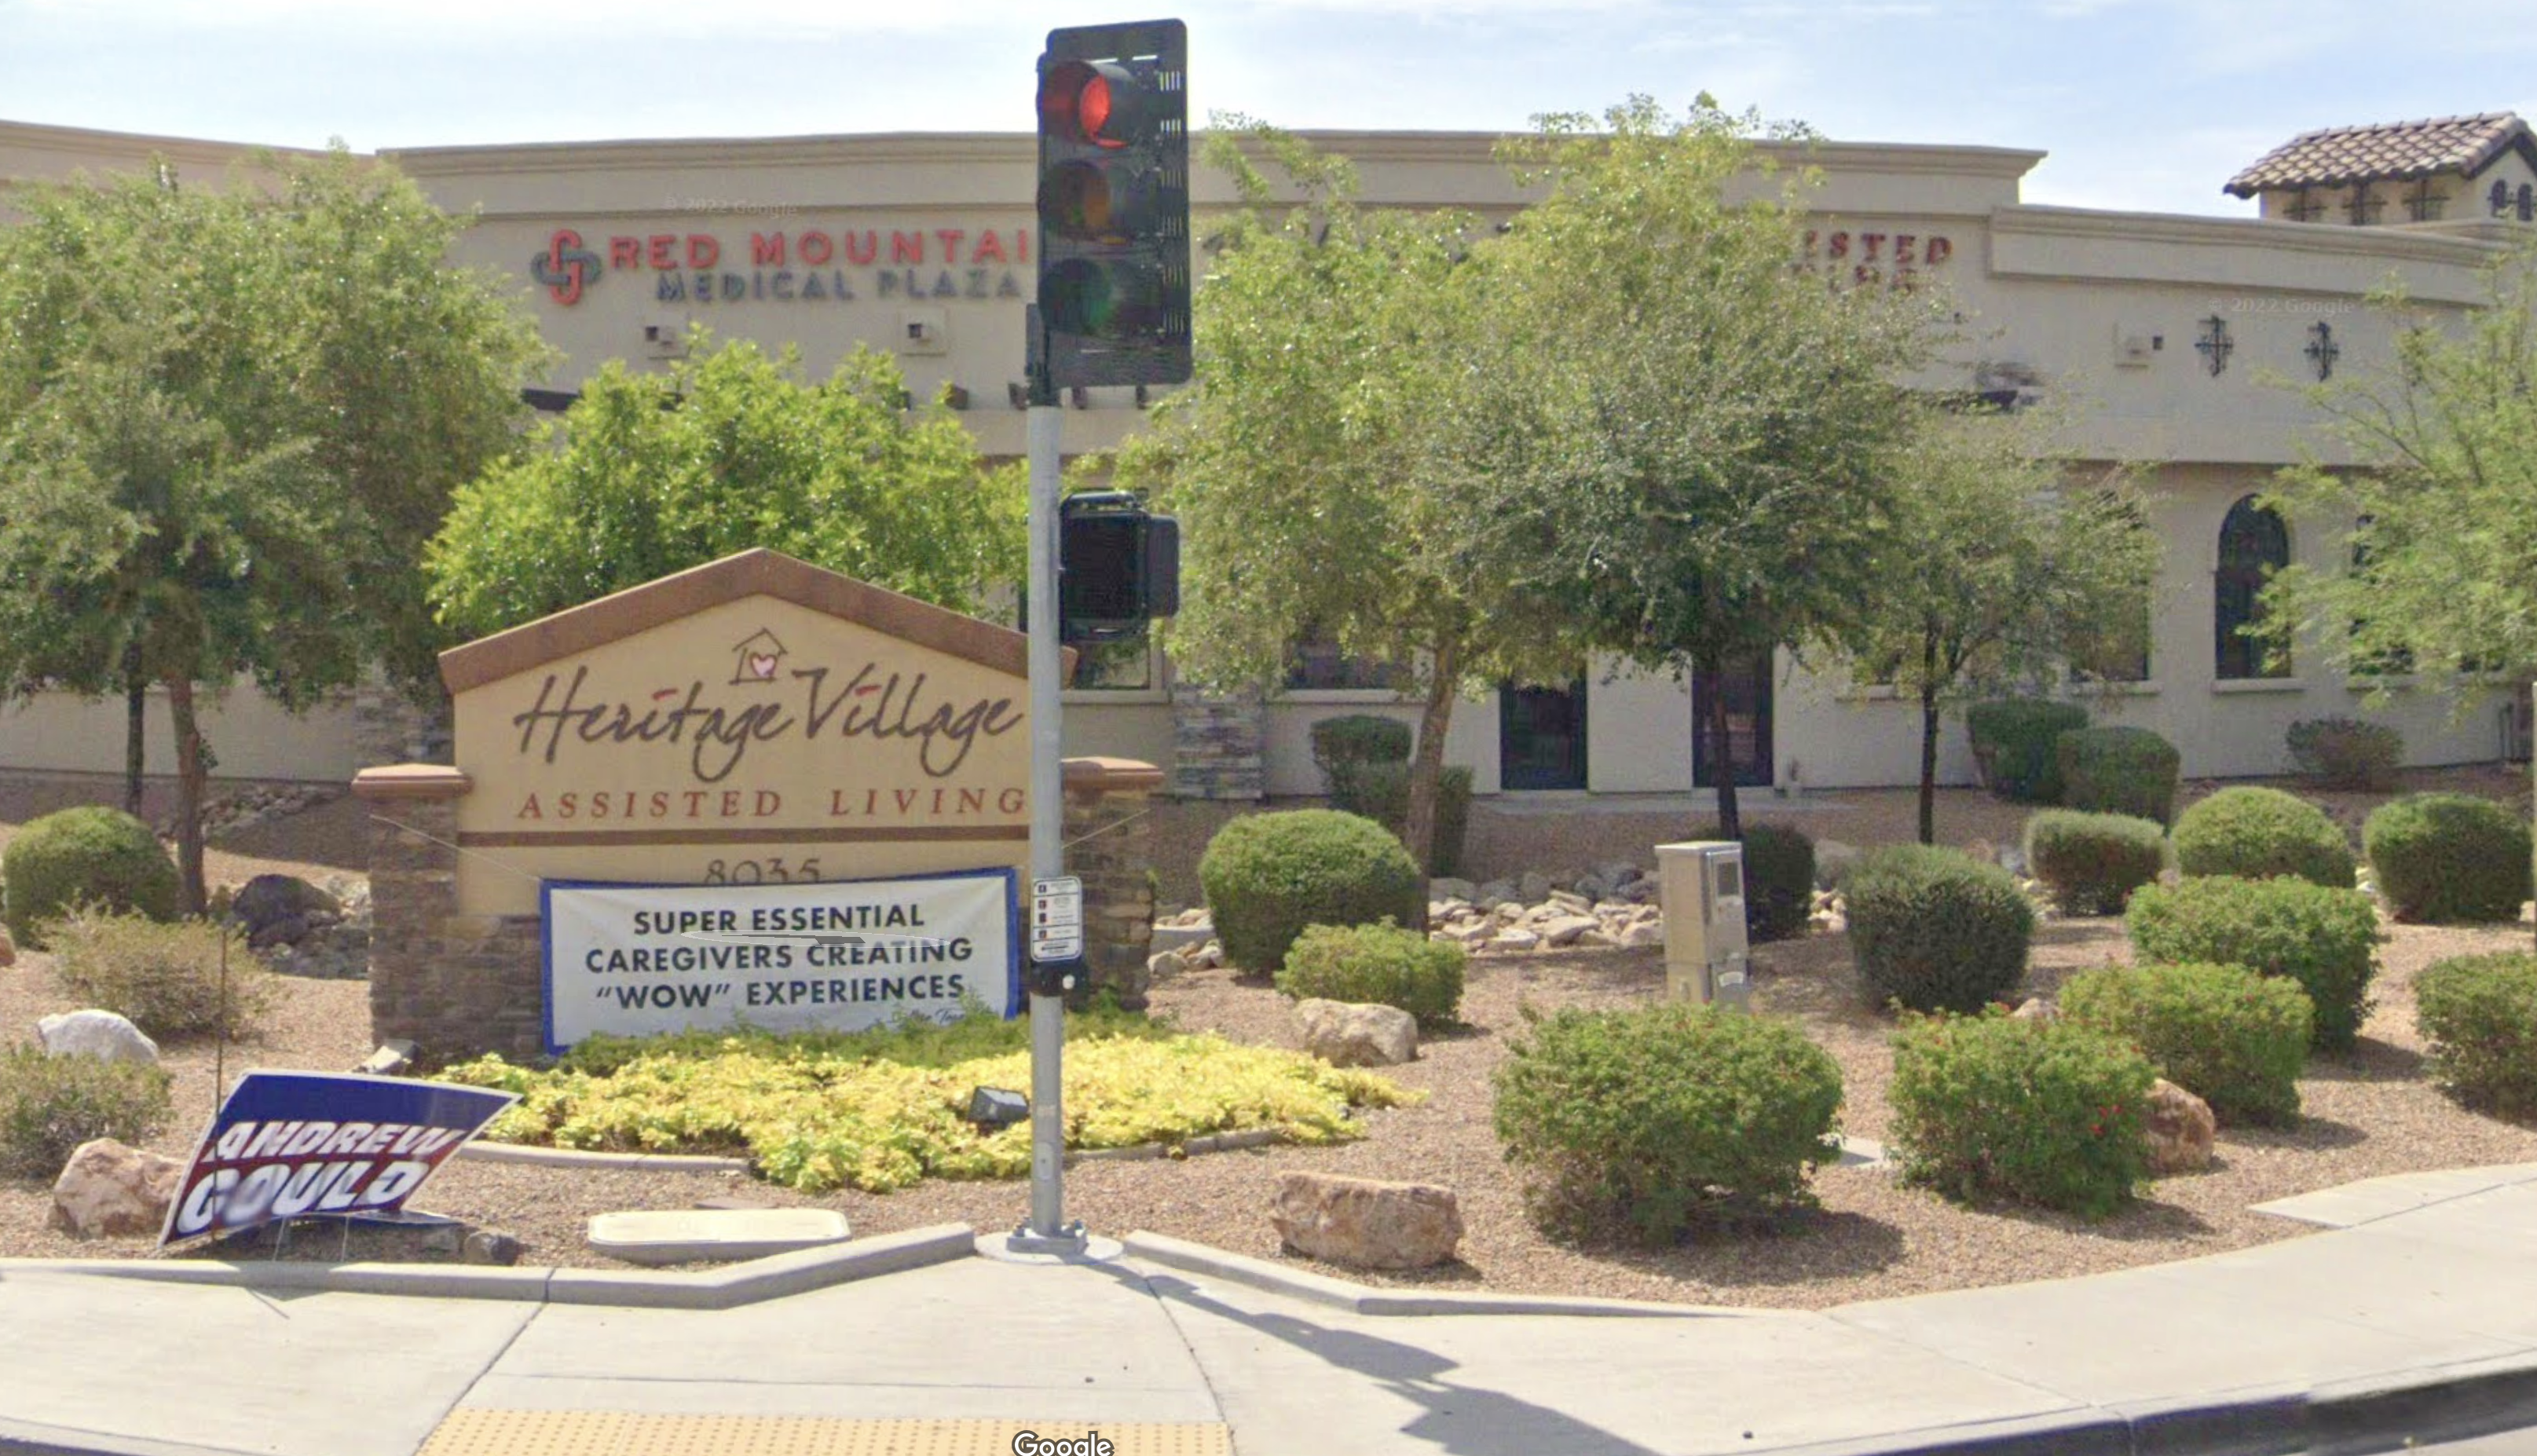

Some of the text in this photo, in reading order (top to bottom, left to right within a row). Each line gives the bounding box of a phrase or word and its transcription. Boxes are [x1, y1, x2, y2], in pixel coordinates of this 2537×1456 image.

[610, 229, 1028, 269] RED MOUNTAI
[657, 268, 1021, 302] MEDICAL PLAZA
[513, 663, 1024, 783] Heritage Village
[517, 788, 1027, 819] ASSISTED LIVING
[704, 858, 821, 884] 8035
[633, 904, 925, 935] SUPER ESSENTIAL
[585, 937, 973, 974] CAREGIVERS CREATING
[747, 974, 965, 1007] EXPERIENCES
[200, 1121, 471, 1163] ANDREW
[176, 1160, 430, 1234] GOULD
